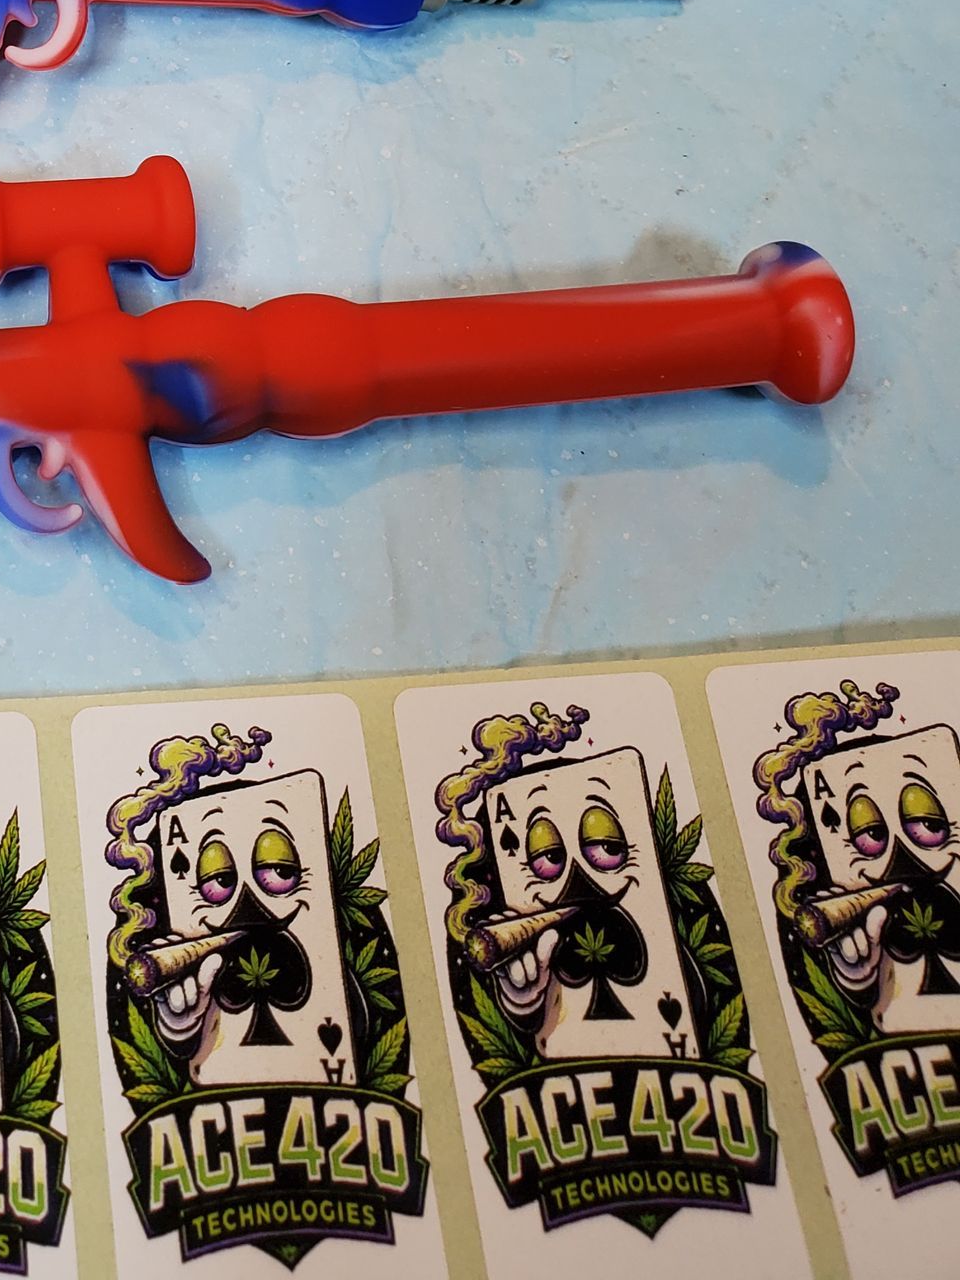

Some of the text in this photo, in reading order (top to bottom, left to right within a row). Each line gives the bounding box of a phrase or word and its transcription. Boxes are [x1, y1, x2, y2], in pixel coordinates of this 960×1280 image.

[812, 769, 836, 799] A
[495, 793, 517, 822] A
[166, 815, 189, 845] A
[841, 1044, 960, 1151] ACE
[504, 1069, 760, 1181] ACE 420
[149, 1097, 408, 1207] ACE 420
[551, 1176, 730, 1210] TECHNOLOGIES
[193, 1198, 376, 1240] TECHNOLOGIES
